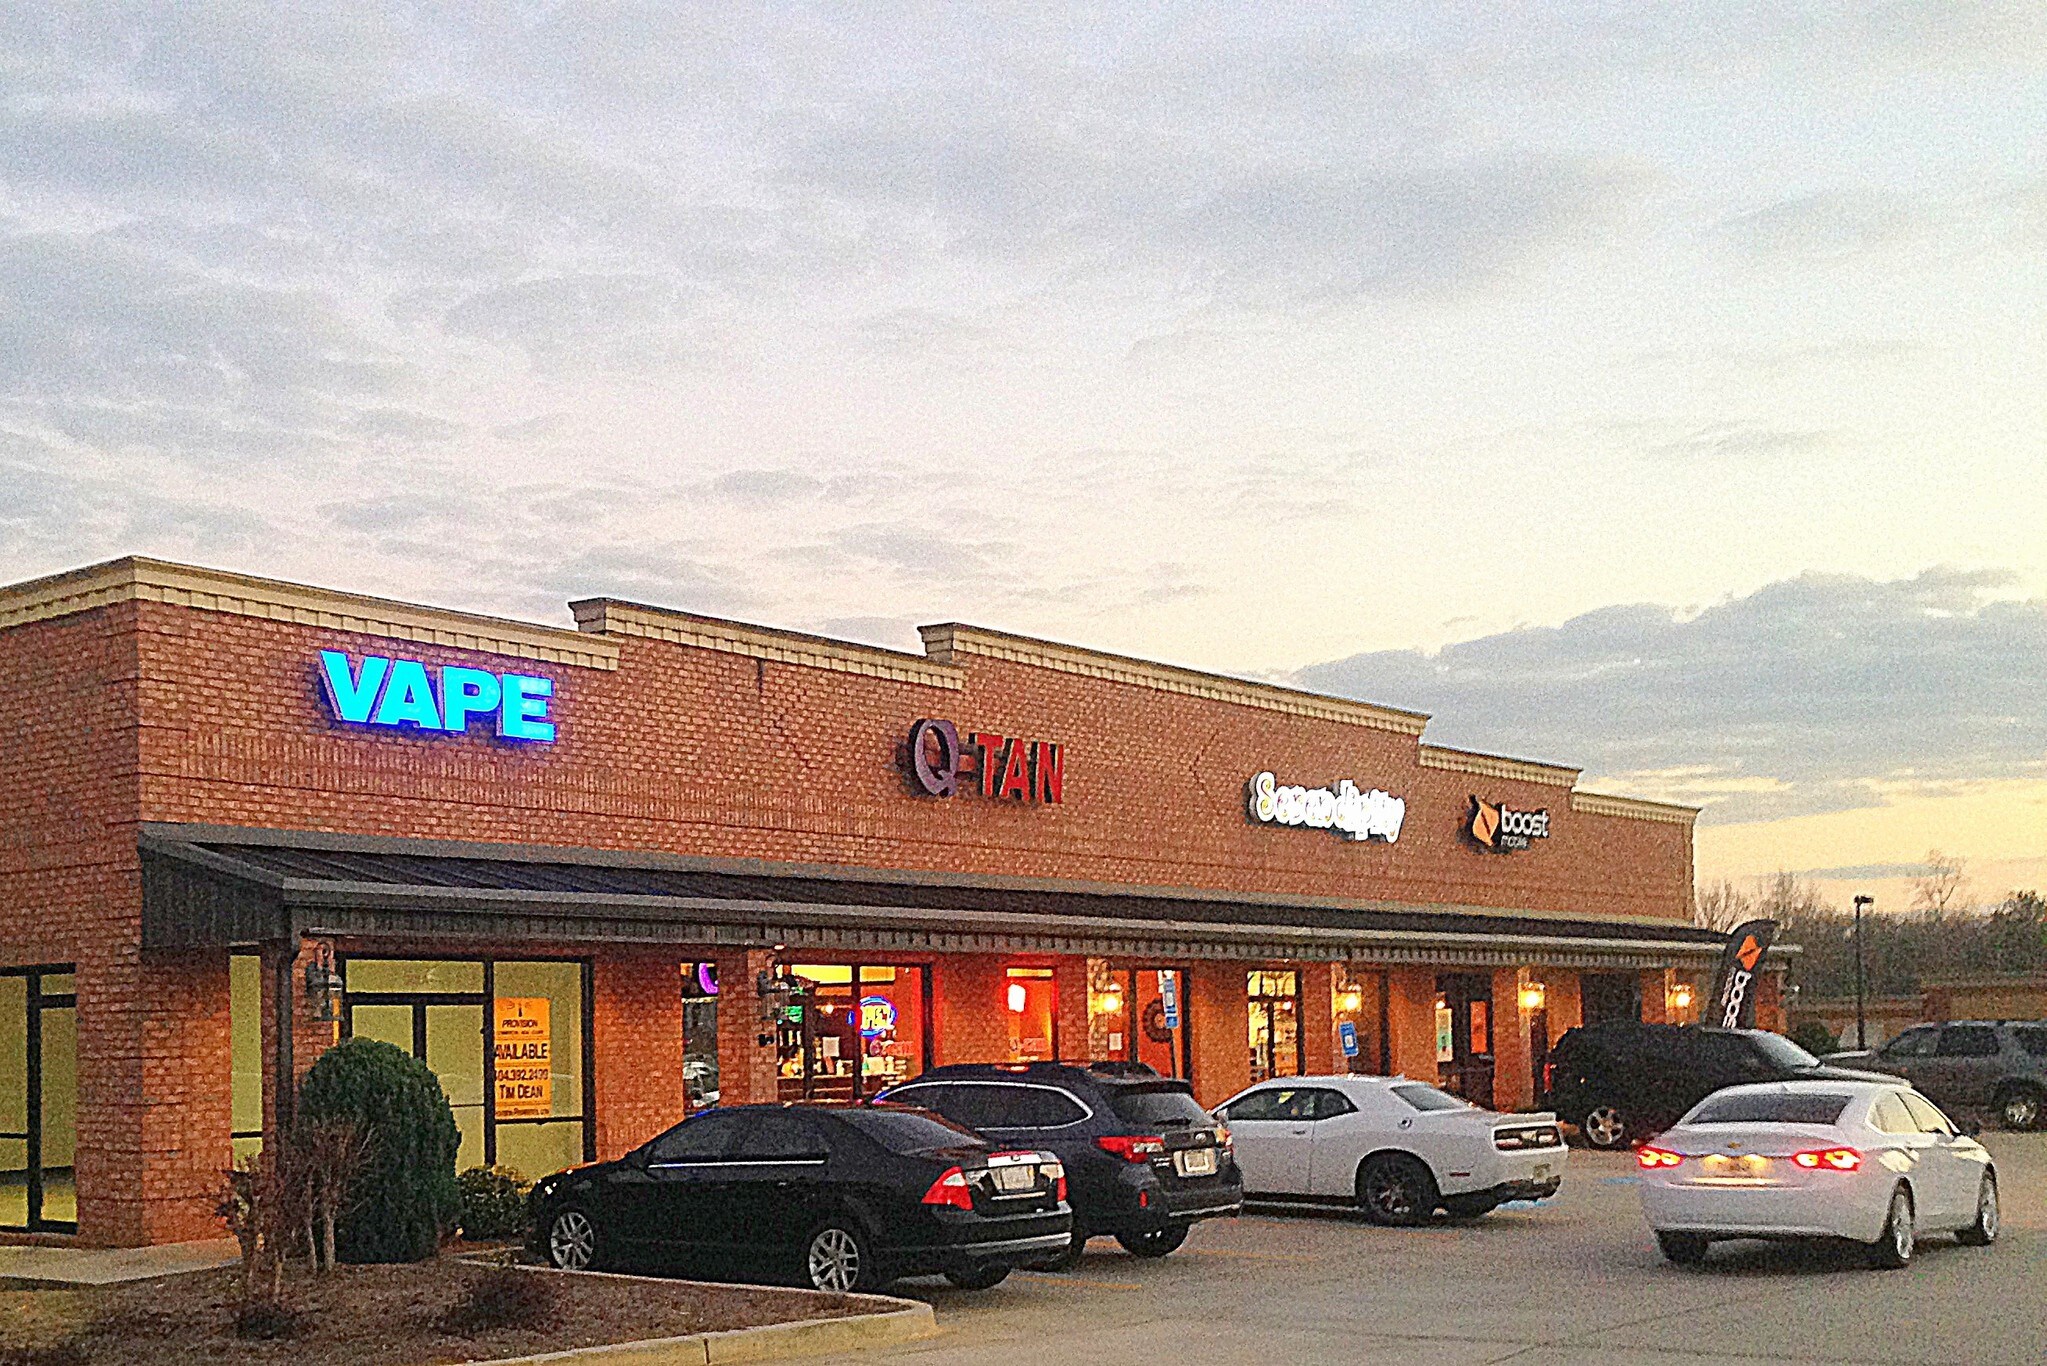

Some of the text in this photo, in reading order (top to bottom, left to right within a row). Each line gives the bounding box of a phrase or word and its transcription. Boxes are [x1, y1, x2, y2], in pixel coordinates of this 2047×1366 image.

[320, 650, 555, 742] VAPE
[913, 718, 1064, 804] Q-TAN
[1501, 804, 1549, 838] boost
[495, 1043, 548, 1059] AVAILABLE
[517, 1083, 543, 1099] DEAN
